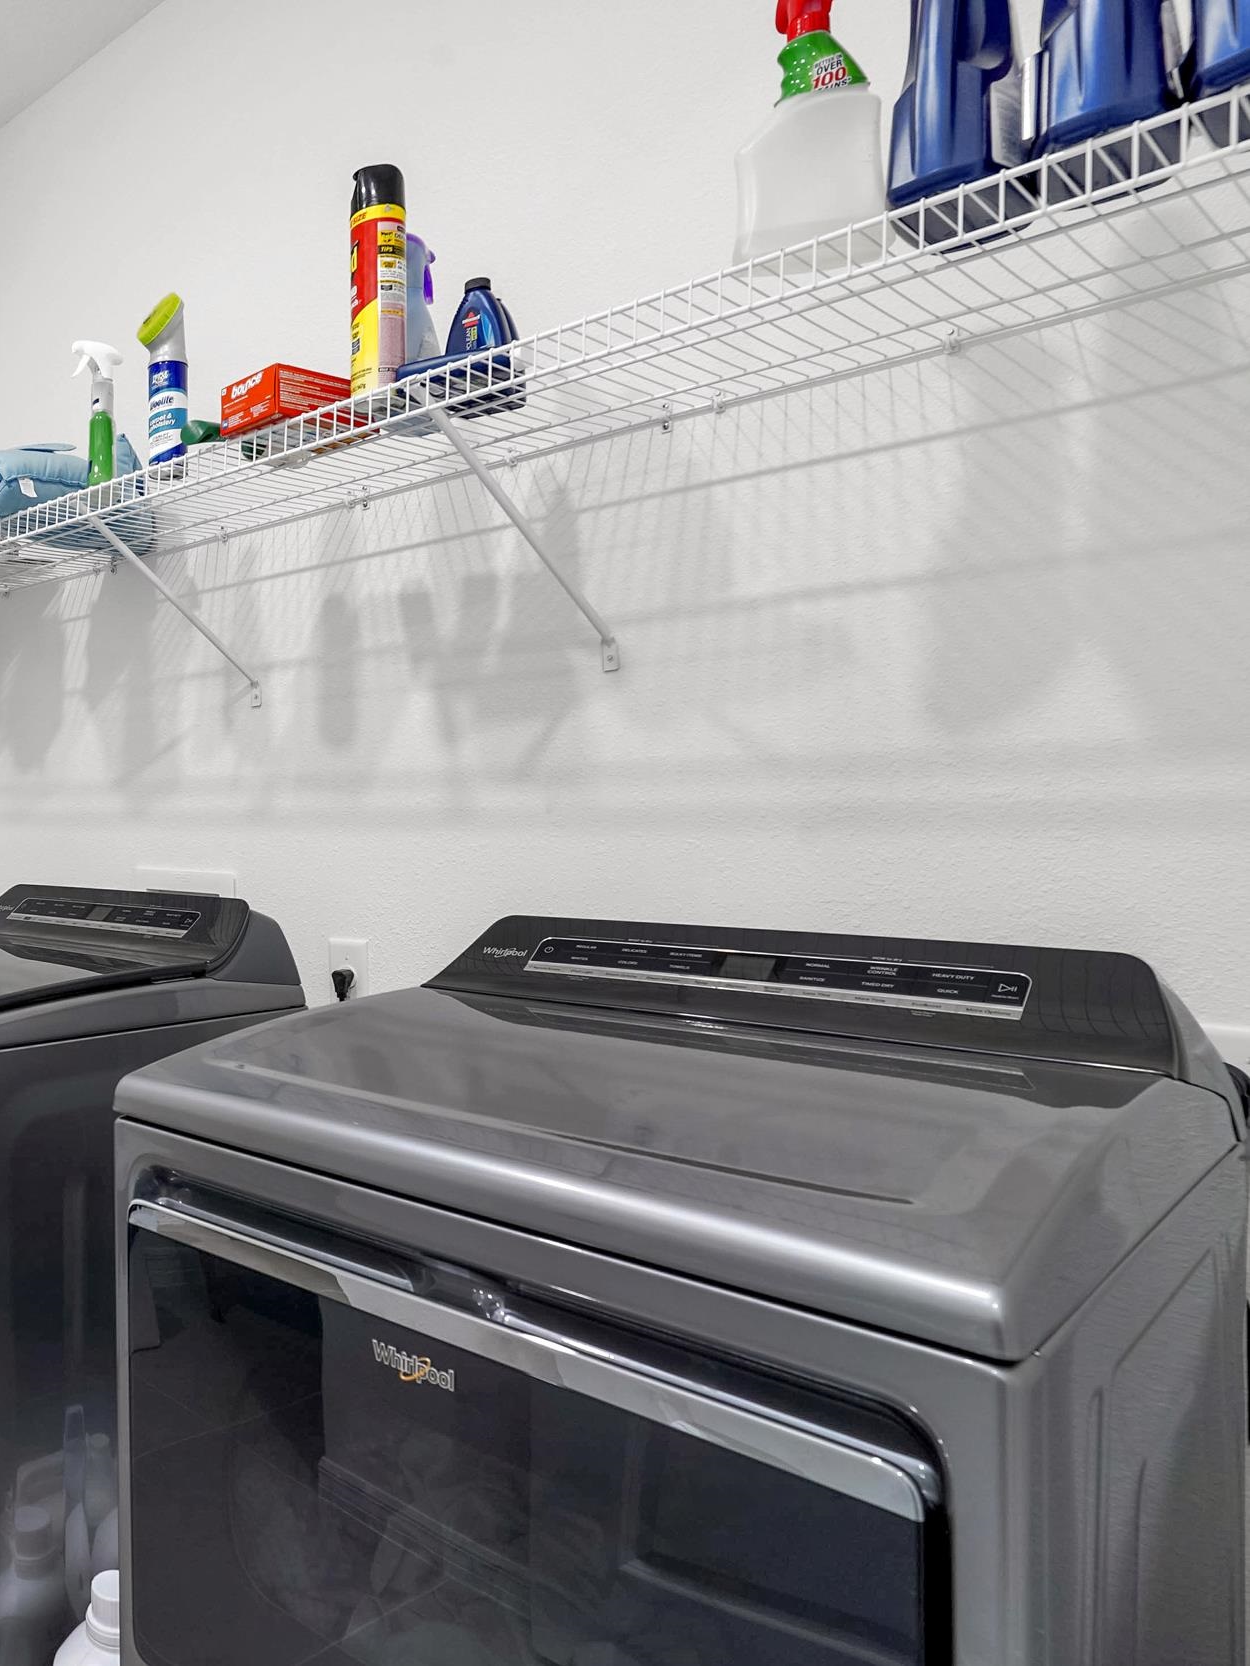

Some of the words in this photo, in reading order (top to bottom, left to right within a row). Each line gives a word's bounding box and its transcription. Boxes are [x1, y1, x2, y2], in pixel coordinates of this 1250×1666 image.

[816, 59, 843, 76] OVER
[813, 66, 847, 90] 100
[231, 371, 264, 400] bounce
[483, 946, 528, 958] Whirlpool
[869, 965, 899, 973] WRINKLE
[932, 972, 956, 980] HEAVY
[936, 987, 959, 995] QUICK
[372, 1338, 455, 1392] Whirlpool
